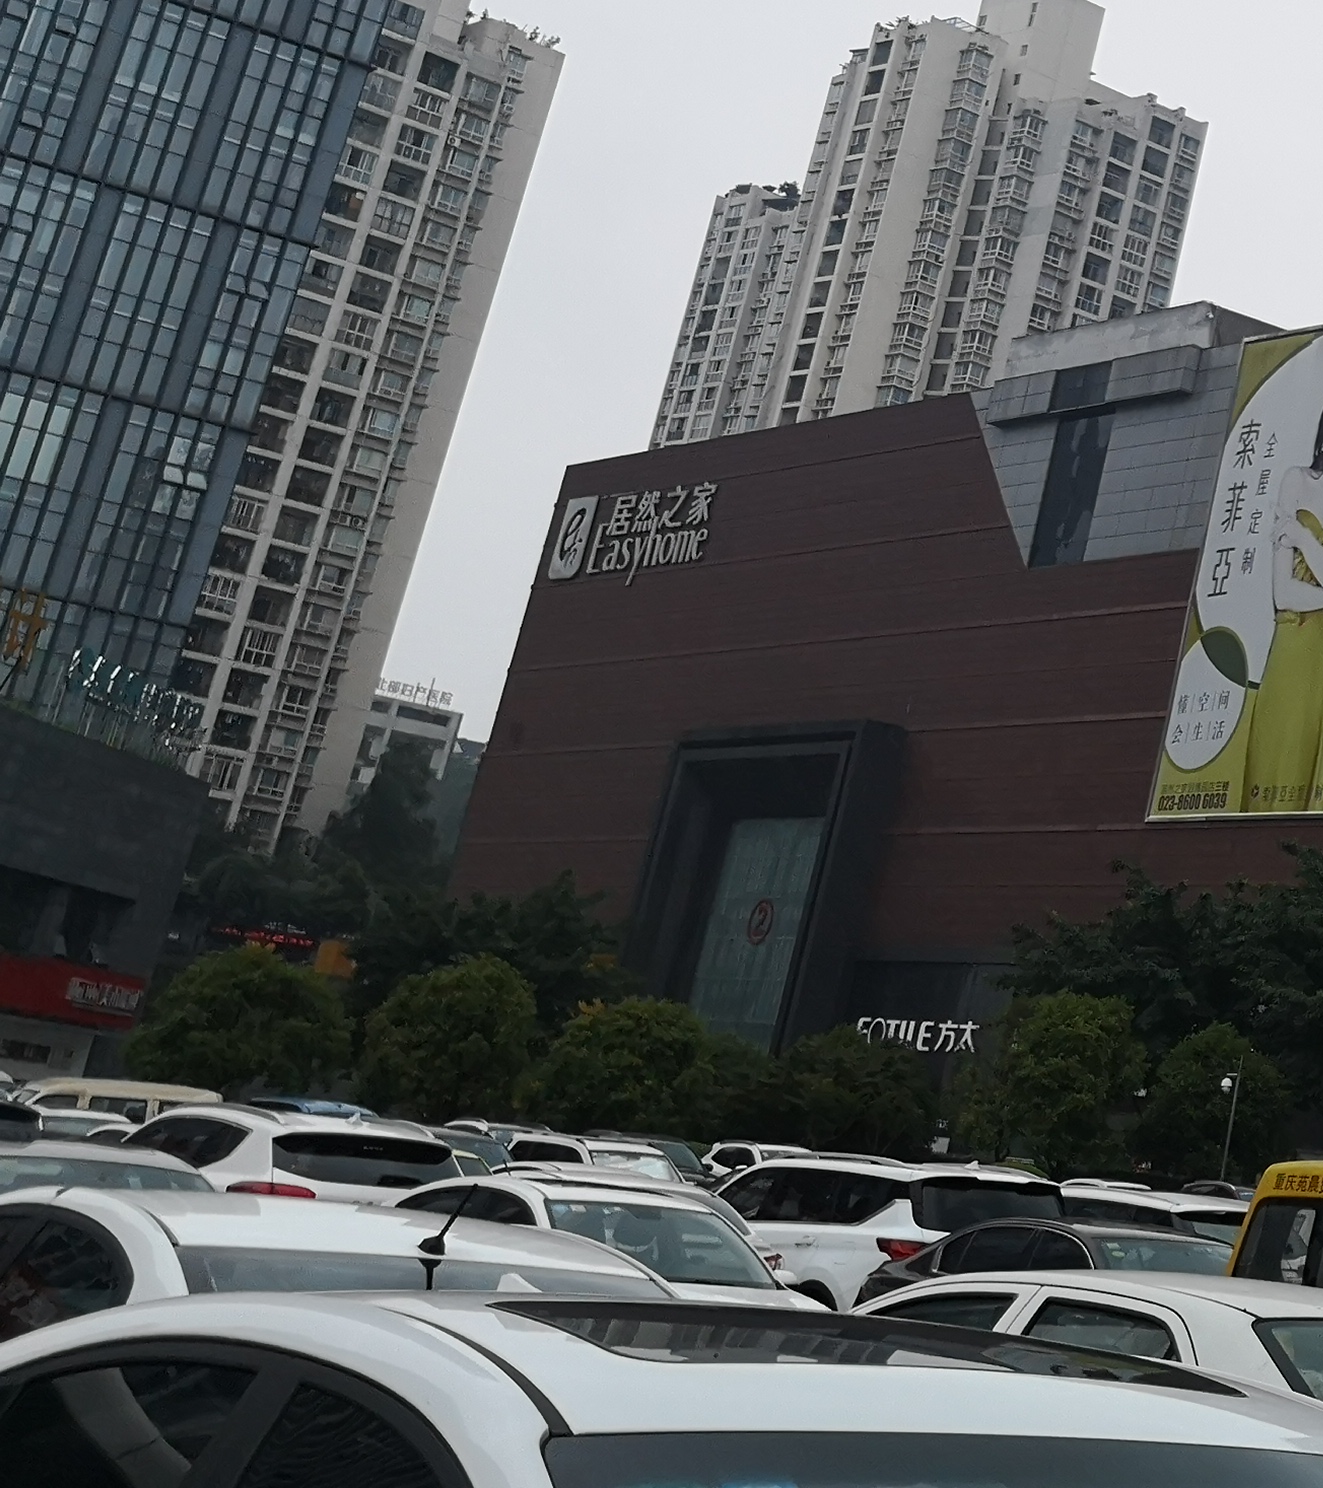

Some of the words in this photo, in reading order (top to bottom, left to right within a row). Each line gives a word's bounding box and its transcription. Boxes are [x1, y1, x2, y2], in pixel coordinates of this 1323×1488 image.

[606, 482, 718, 536] 居然之家
[1241, 432, 1278, 575] 全屋定制
[586, 527, 708, 587] Easyhome
